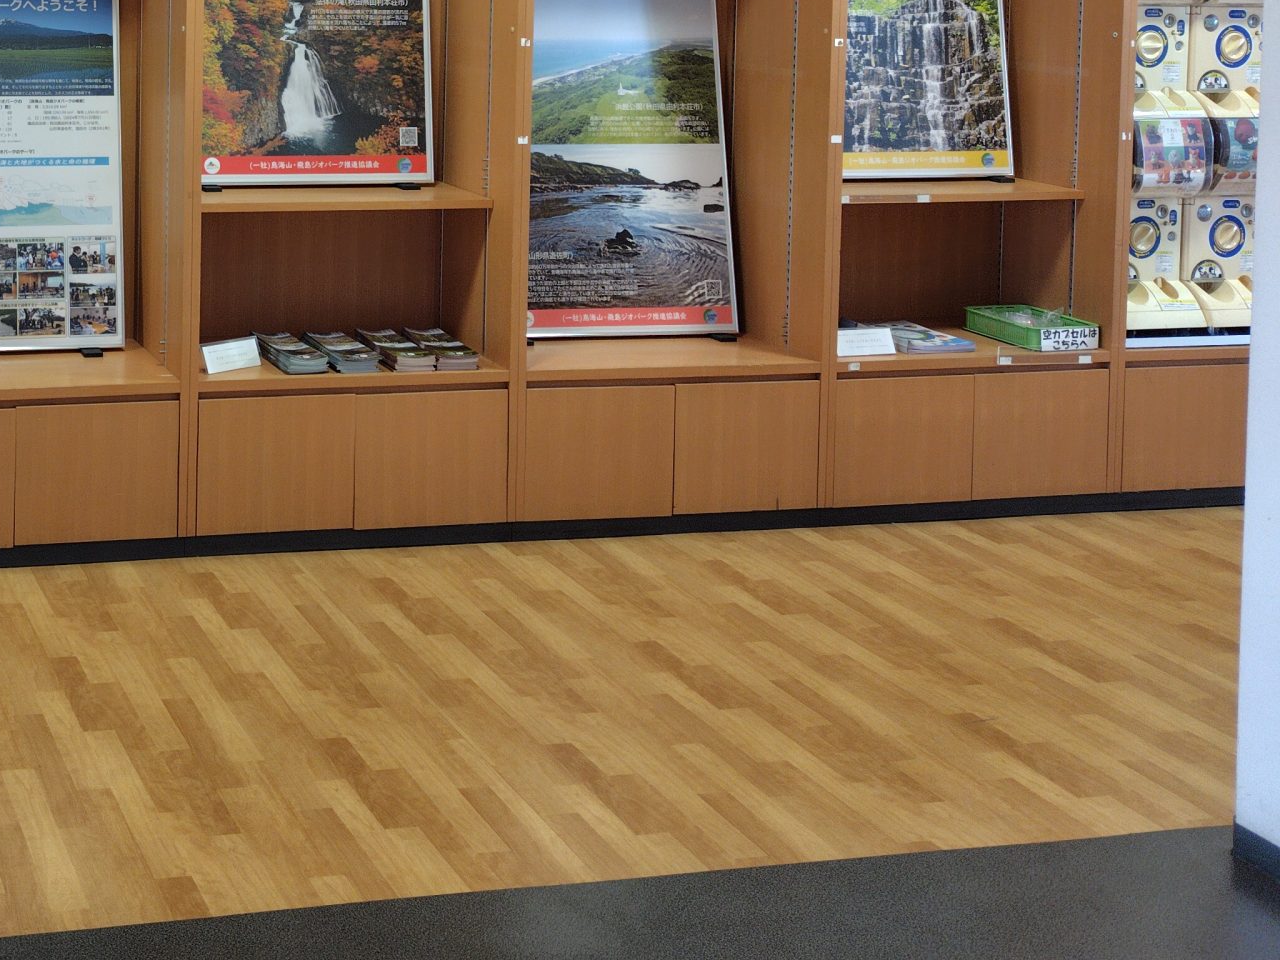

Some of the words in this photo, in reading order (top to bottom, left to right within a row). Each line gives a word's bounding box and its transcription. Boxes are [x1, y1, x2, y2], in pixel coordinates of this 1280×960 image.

[1042, 328, 1098, 340] 空カプセルは
[1052, 339, 1089, 350] こちらへ
